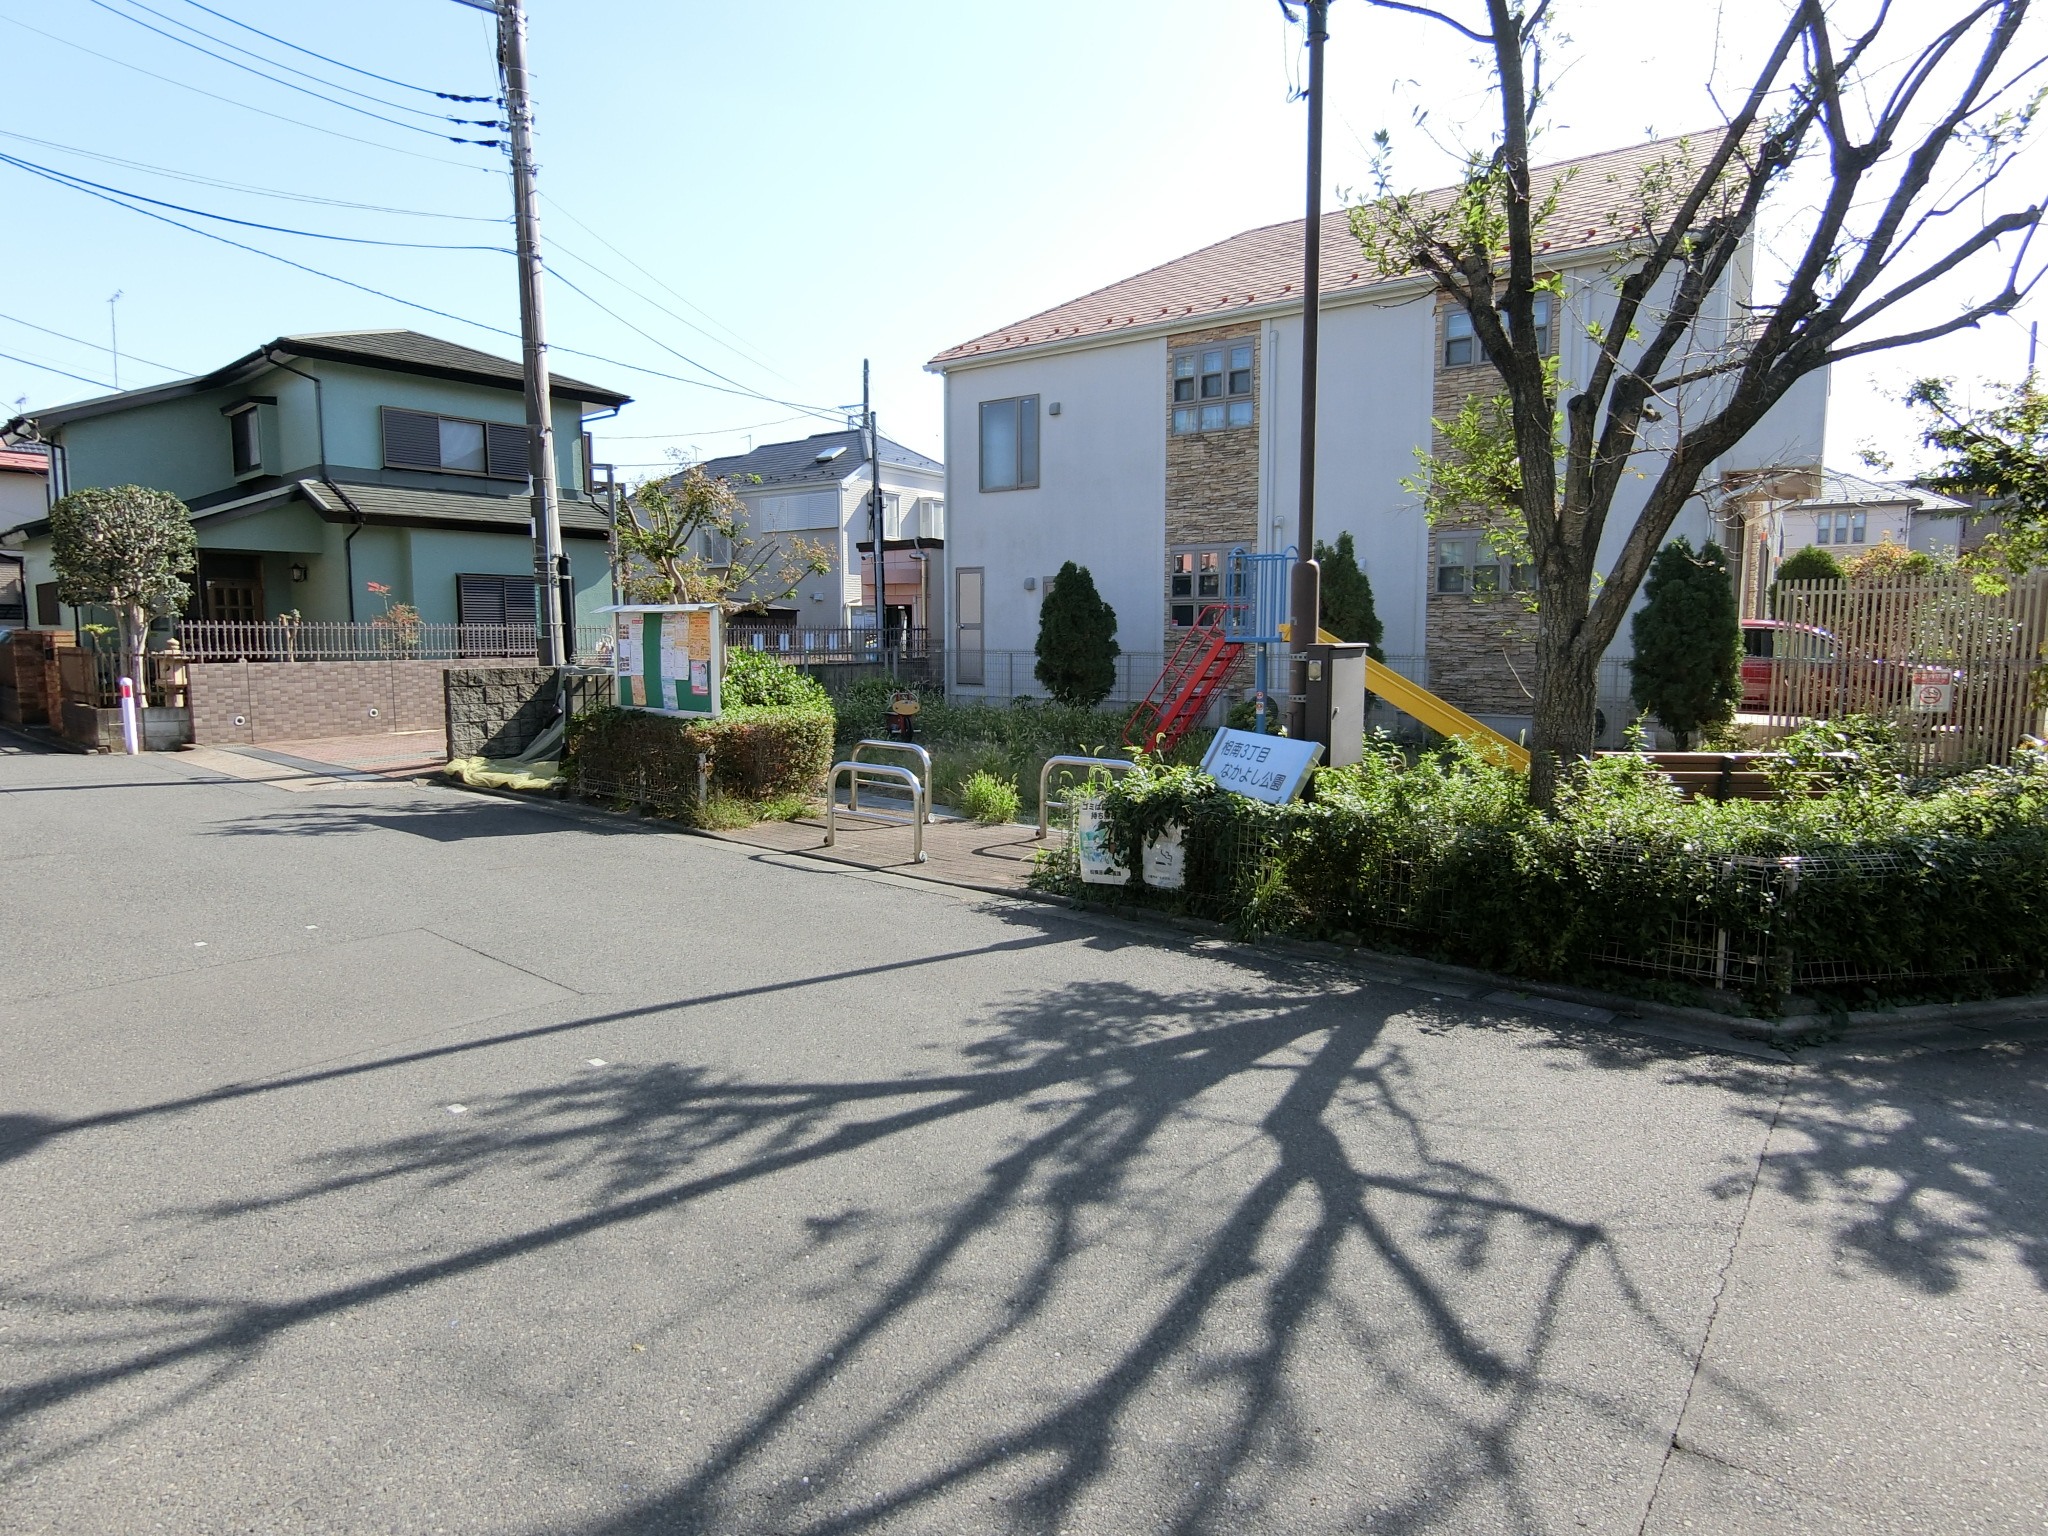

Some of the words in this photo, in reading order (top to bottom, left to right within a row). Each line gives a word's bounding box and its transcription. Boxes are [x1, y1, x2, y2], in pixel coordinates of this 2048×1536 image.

[1221, 740, 1271, 763] 相南3丁目
[1220, 762, 1287, 791] なかよし公園
